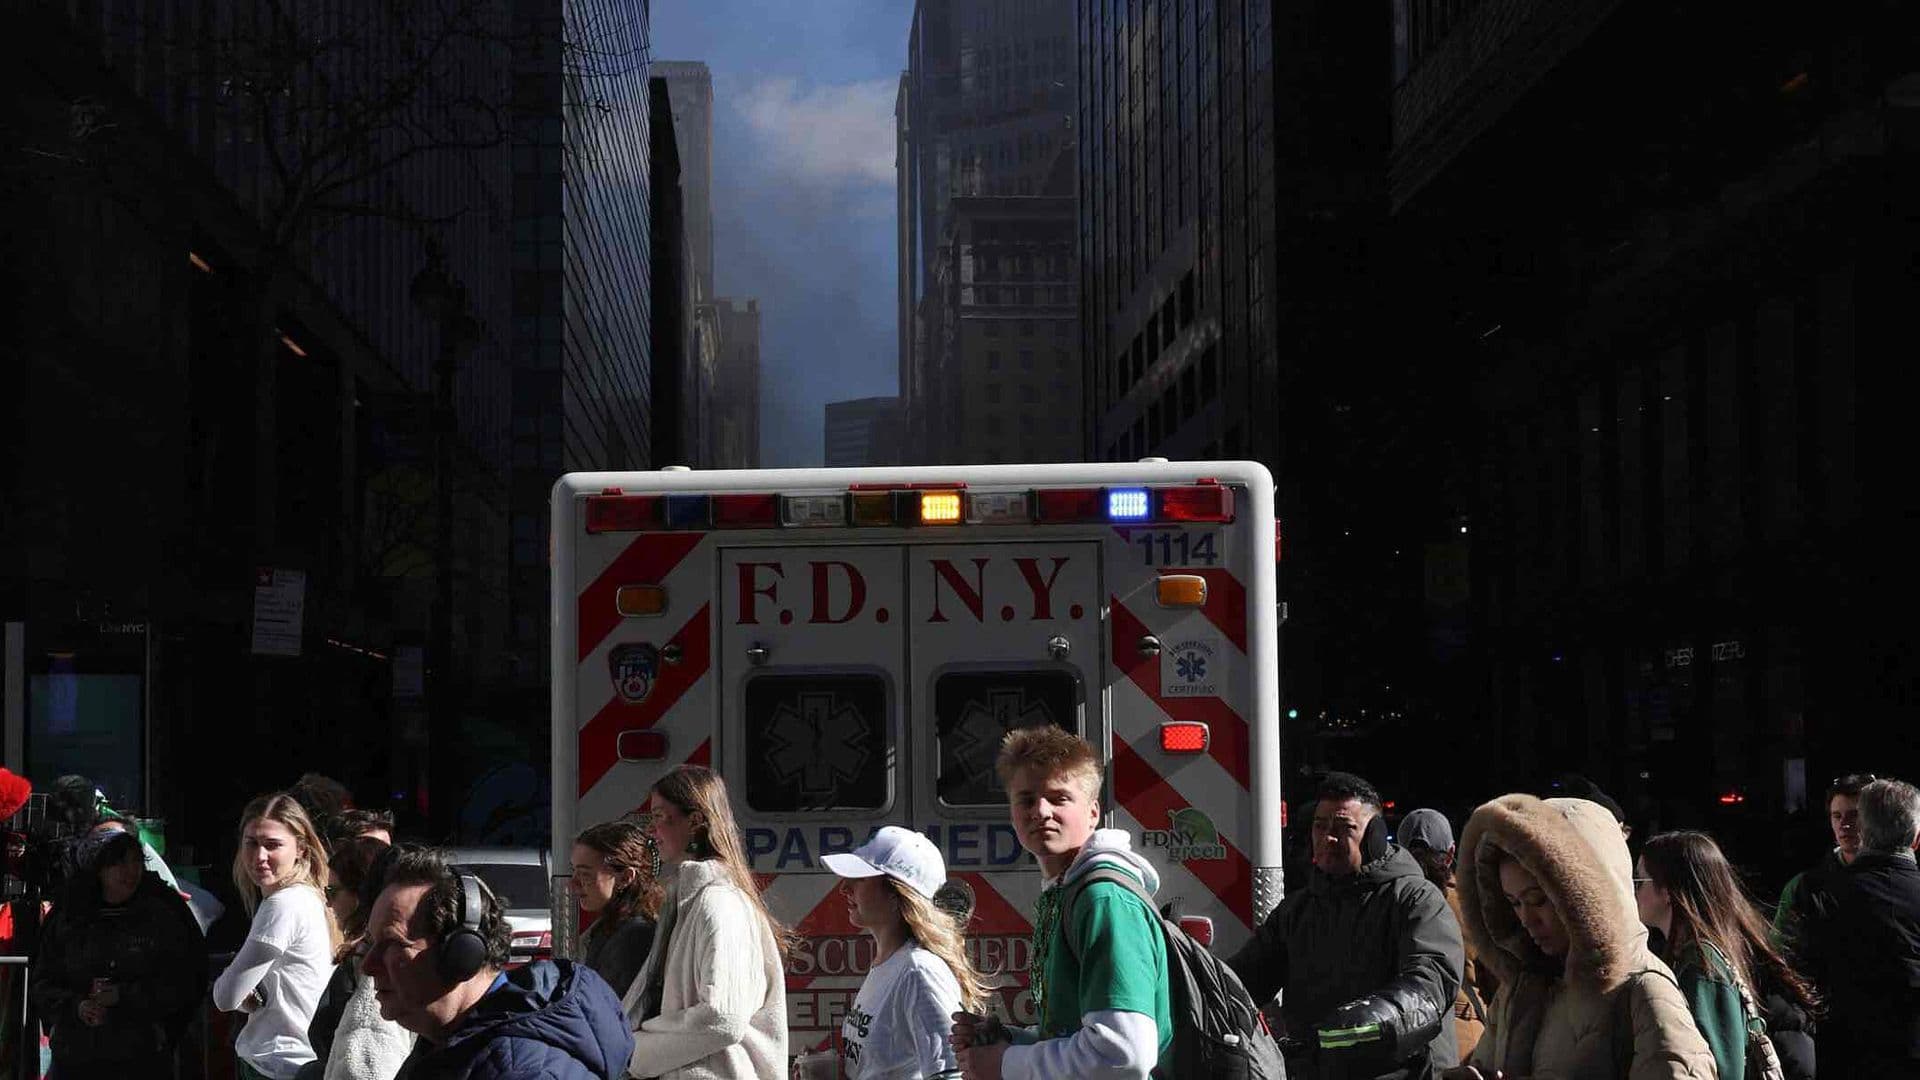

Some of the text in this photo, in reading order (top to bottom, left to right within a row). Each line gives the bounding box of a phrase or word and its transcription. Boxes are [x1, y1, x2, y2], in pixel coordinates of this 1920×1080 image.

[1136, 532, 1218, 566] 1114
[735, 557, 1084, 626] F.D. N.Y.
[1141, 831, 1198, 847] FDNY
